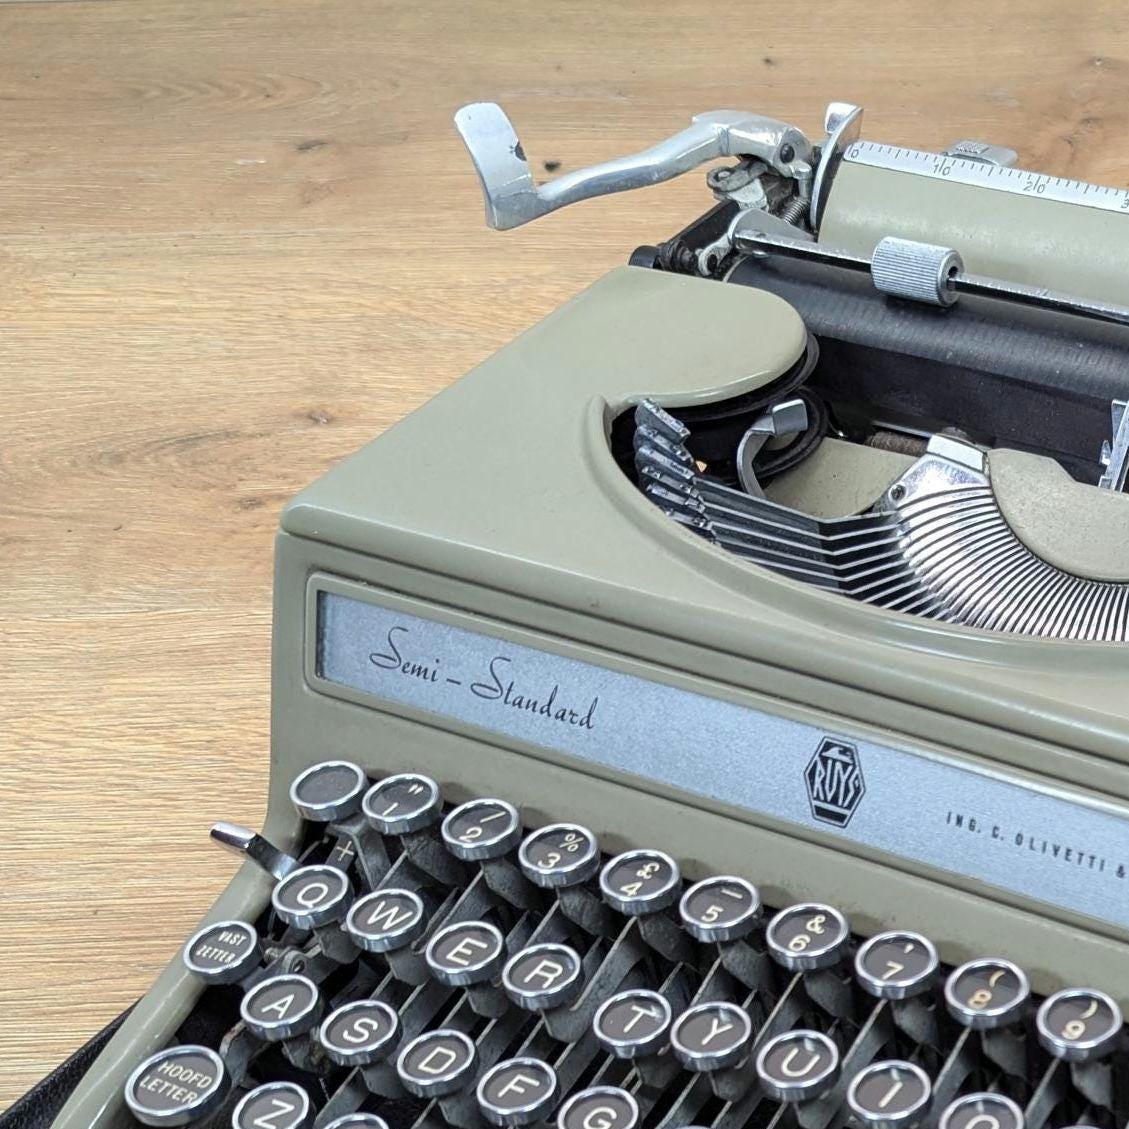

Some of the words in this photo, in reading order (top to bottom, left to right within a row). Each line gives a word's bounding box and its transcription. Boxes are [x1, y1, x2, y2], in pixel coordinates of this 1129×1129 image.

[368, 626, 441, 683] Semi
[470, 656, 599, 730] Standard
[459, 826, 483, 842] 2
[558, 832, 584, 852] %
[946, 811, 981, 833] ING.
[991, 825, 1004, 841] C.
[1014, 832, 1105, 872] OLIVETTI
[1116, 865, 1125, 878] &
[537, 852, 561, 869] 3
[297, 882, 329, 909] Q
[619, 881, 643, 897] 4
[367, 901, 413, 930] W
[701, 904, 724, 923] 5
[806, 914, 826, 935] &
[218, 931, 247, 947] VAST
[446, 937, 488, 966] E
[788, 934, 811, 951] 6
[196, 945, 237, 965] LETTER
[524, 960, 563, 989] R
[882, 960, 905, 980] 7
[261, 993, 295, 1020] A
[967, 988, 993, 1009] 8
[342, 1017, 379, 1043] S
[623, 1004, 659, 1034] T
[701, 1018, 733, 1046] Y
[1061, 1019, 1086, 1041] 9
[417, 1046, 457, 1074] D
[781, 1047, 820, 1077] U
[157, 1061, 214, 1089] HOOFD
[497, 1074, 540, 1098] F
[138, 1075, 198, 1104] LETTER
